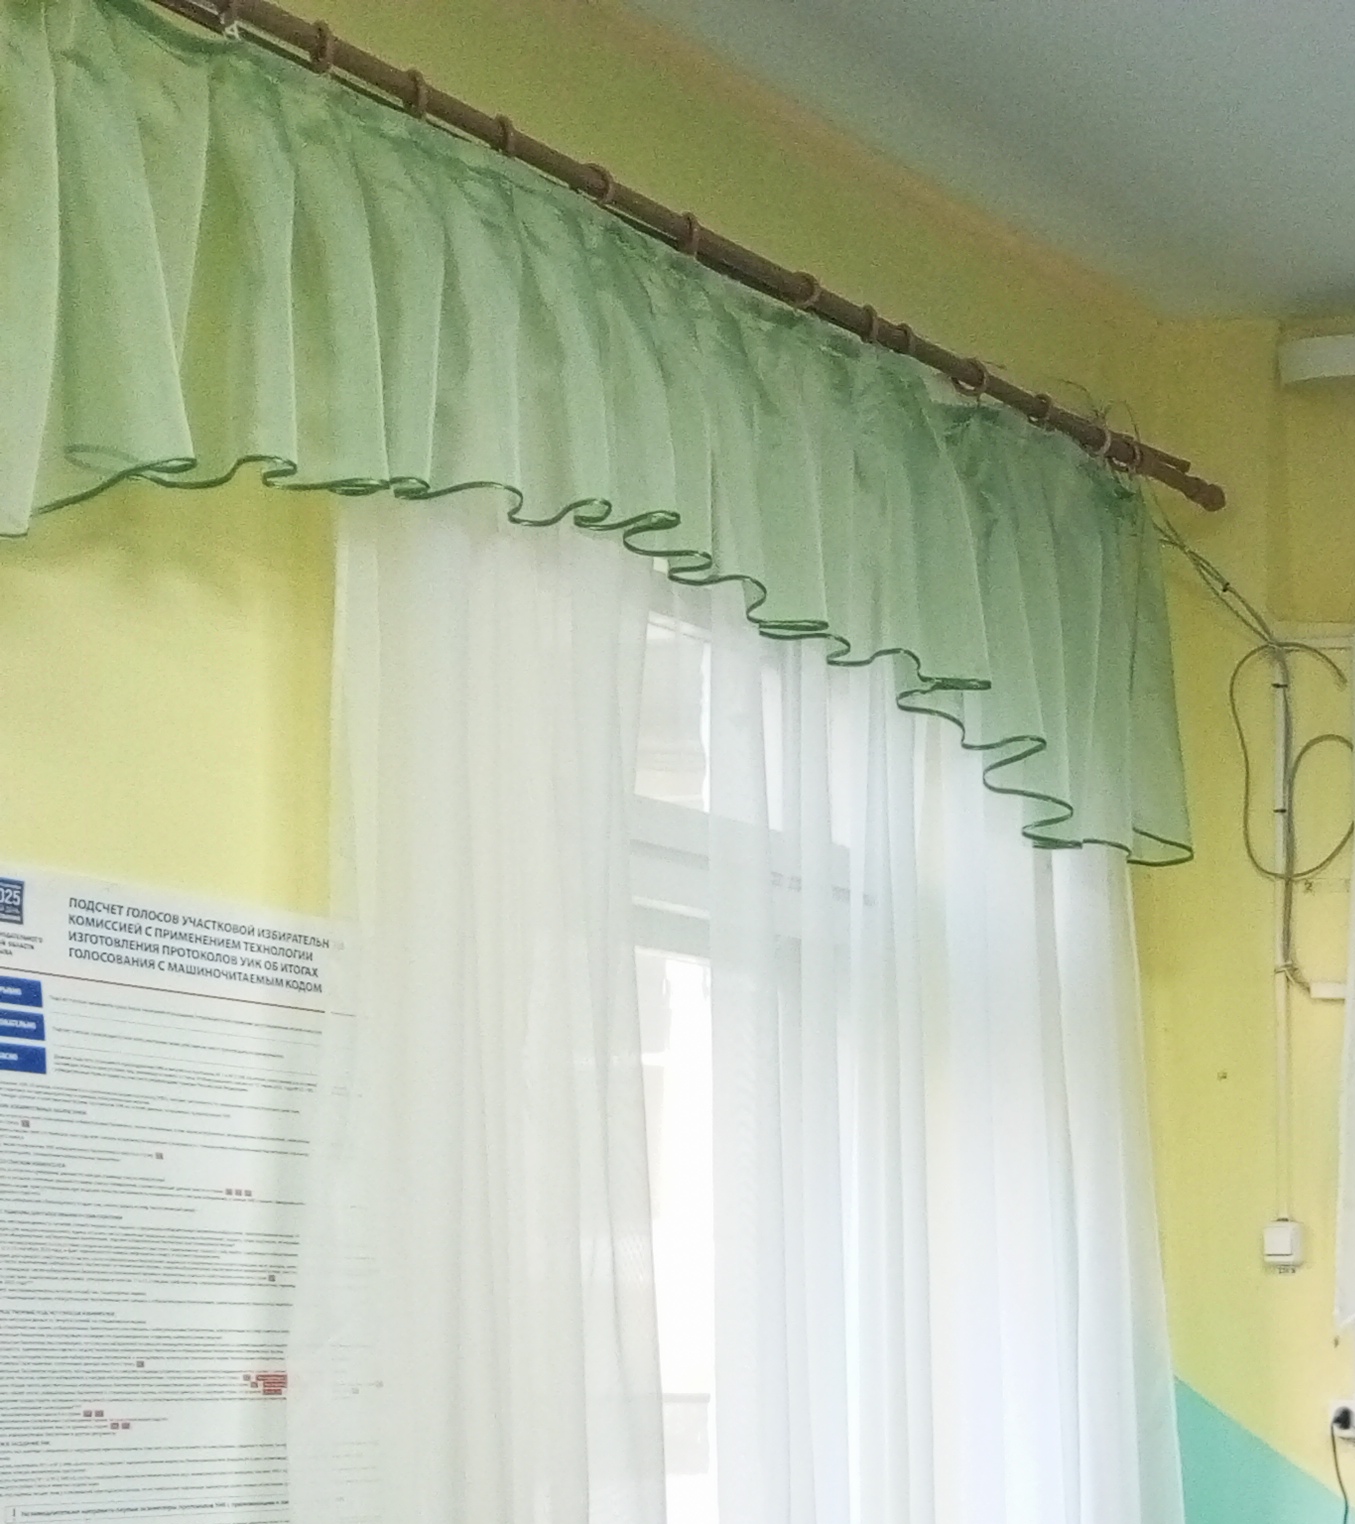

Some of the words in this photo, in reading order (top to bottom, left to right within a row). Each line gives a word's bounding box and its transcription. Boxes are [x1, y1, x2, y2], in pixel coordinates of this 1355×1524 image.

[69, 897, 124, 915] ПОДСЧЕТ
[127, 906, 179, 924] ГОЛОСОВ
[182, 916, 255, 936] УЧАСТКОВОЙ
[69, 914, 142, 935] КОМИССИЕЙ
[145, 926, 152, 937] С
[154, 927, 241, 949] ПРИМЕНЕНИЕМ
[243, 941, 313, 961] ТЕХНОЛОГИИ
[69, 931, 159, 953] ИЗГОТОВЛЕНИЯ
[162, 945, 238, 966] ПРОТОКОЛОВ
[240, 956, 262, 969] УИК
[264, 960, 278, 971] ОБ
[280, 962, 319, 978] ИТОГАХ
[69, 947, 155, 969] ГОЛОСОВАНИЯ
[158, 960, 165, 972] С
[167, 962, 284, 988] МАШИНОЧИТАЕМЫМ
[285, 977, 323, 993] КОДОМ
